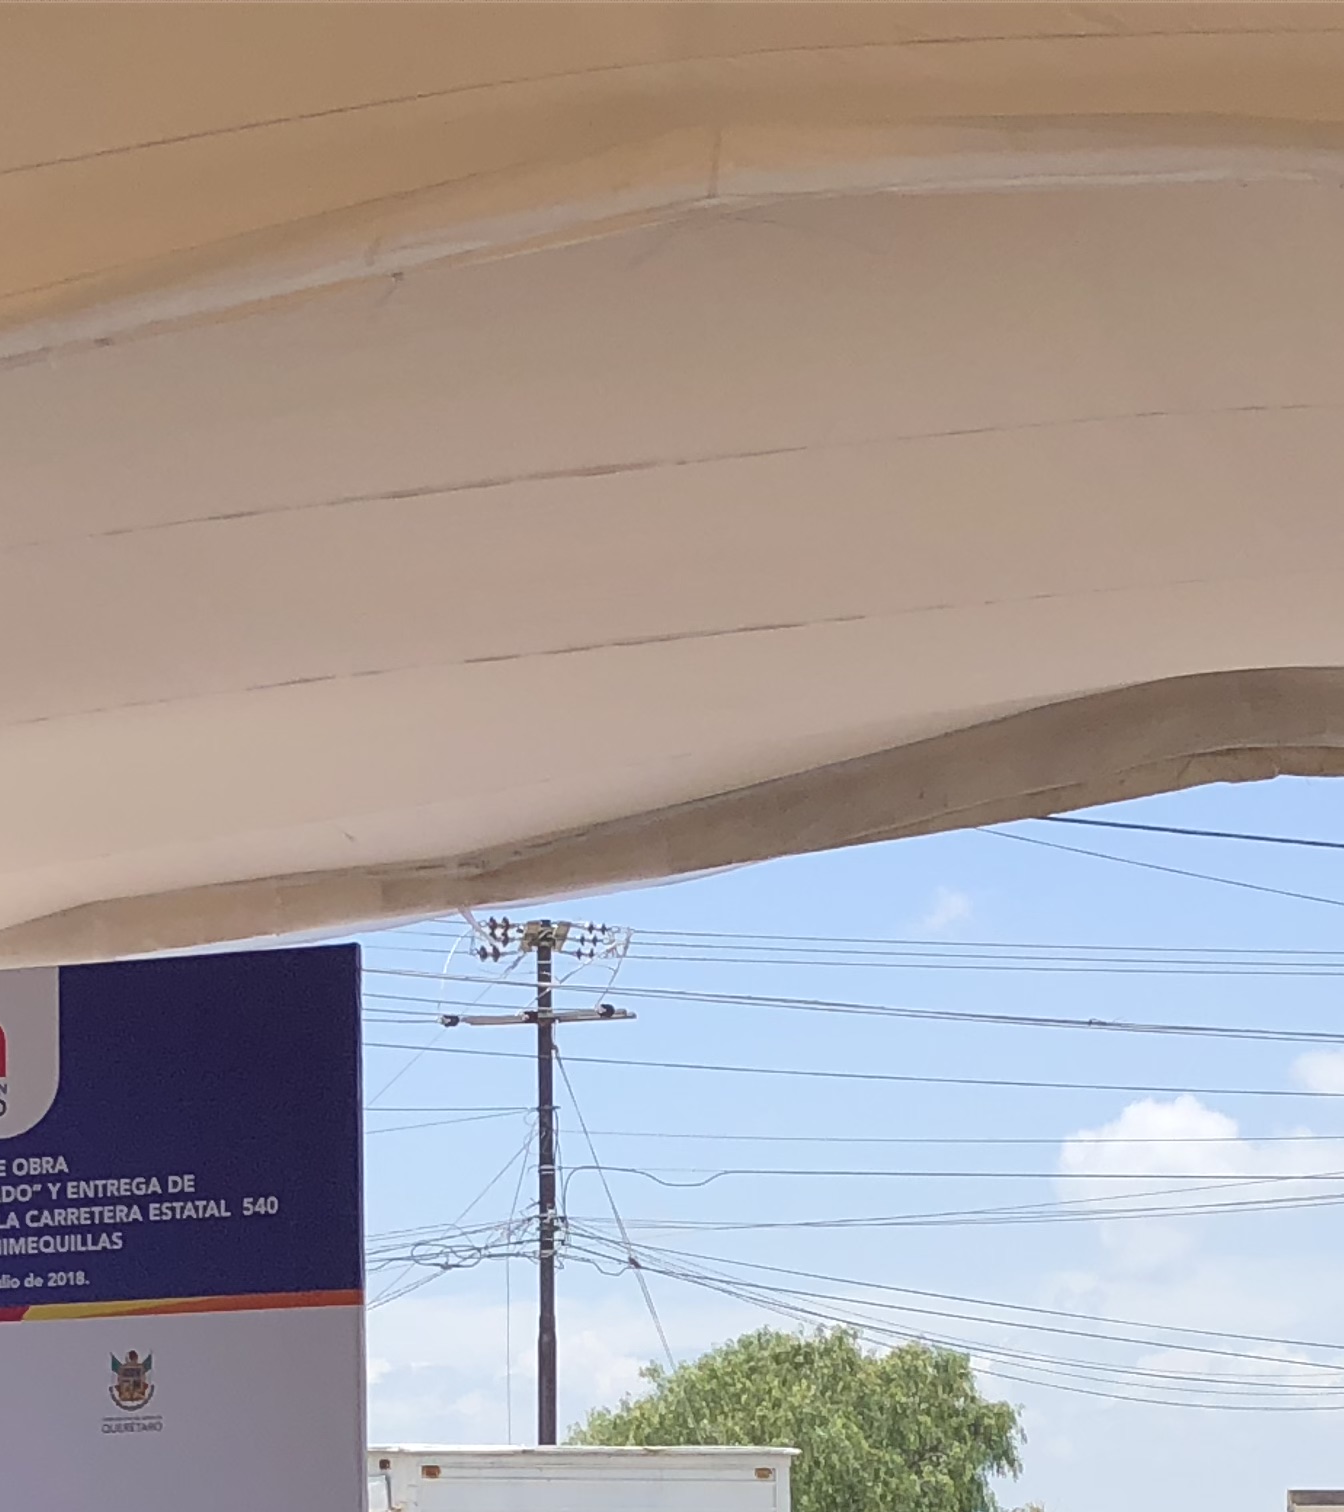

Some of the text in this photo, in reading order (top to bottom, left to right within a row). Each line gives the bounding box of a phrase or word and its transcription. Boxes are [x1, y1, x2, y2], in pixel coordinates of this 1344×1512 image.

[12, 1156, 69, 1177] OBRA
[47, 1182, 62, 1199] Y
[67, 1176, 162, 1199] ENTREGA
[167, 1174, 196, 1193] DE
[25, 1203, 143, 1227] CARRETERA
[149, 1199, 232, 1221] ESTATAL
[242, 1196, 279, 1216] 540
[24, 1273, 44, 1289] de
[47, 1271, 90, 1287] 2018.
